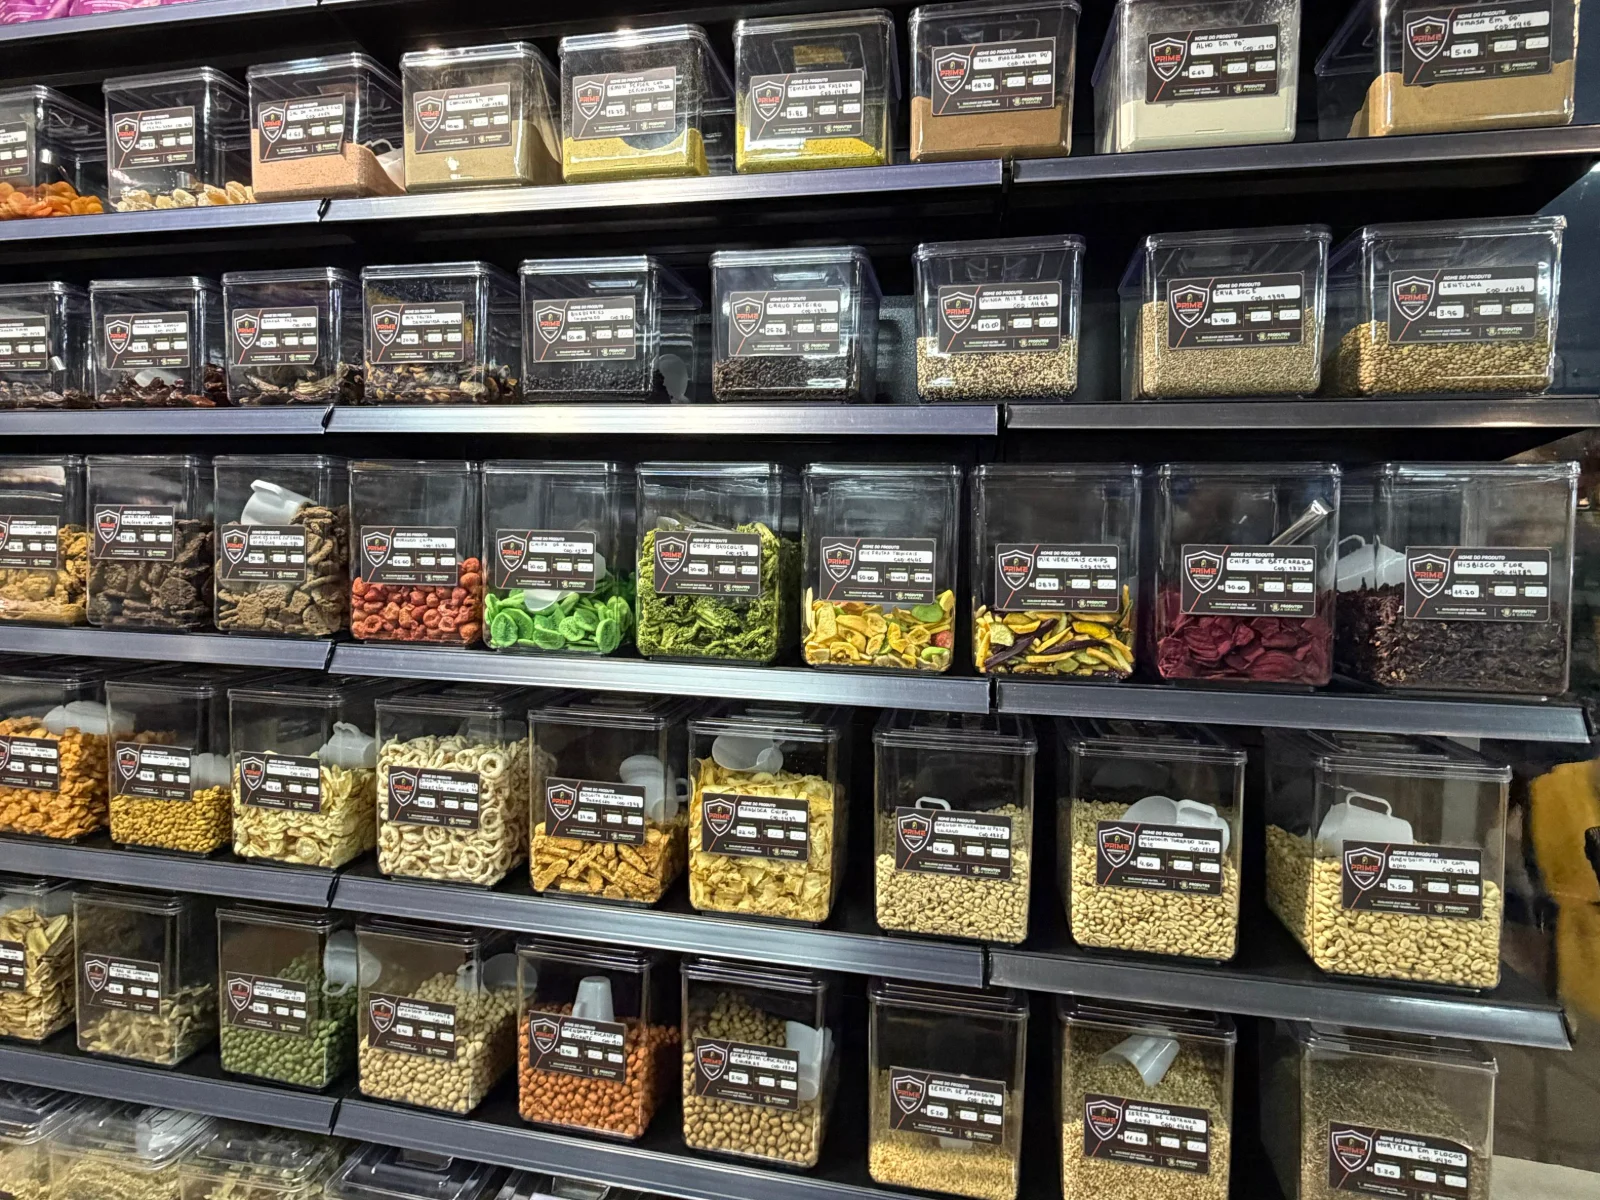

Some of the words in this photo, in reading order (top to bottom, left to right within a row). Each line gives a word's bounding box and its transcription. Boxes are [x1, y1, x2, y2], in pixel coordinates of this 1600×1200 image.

[1412, 34, 1444, 43] PRIME
[1196, 42, 1213, 50] ALHO
[1154, 54, 1182, 62] PRIME
[757, 96, 780, 104] PRIME
[1398, 294, 1428, 302] PRIME
[1190, 567, 1218, 575] PRIME
[1414, 571, 1443, 579] PRIME
[708, 812, 730, 820] PRIME
[902, 828, 926, 836] PRIME
[1104, 842, 1130, 850] PRIME
[1351, 864, 1379, 872] PRIME
[897, 1090, 920, 1098] PRIME
[1092, 1115, 1116, 1124] PRIME
[1338, 1145, 1366, 1156] PRIME
